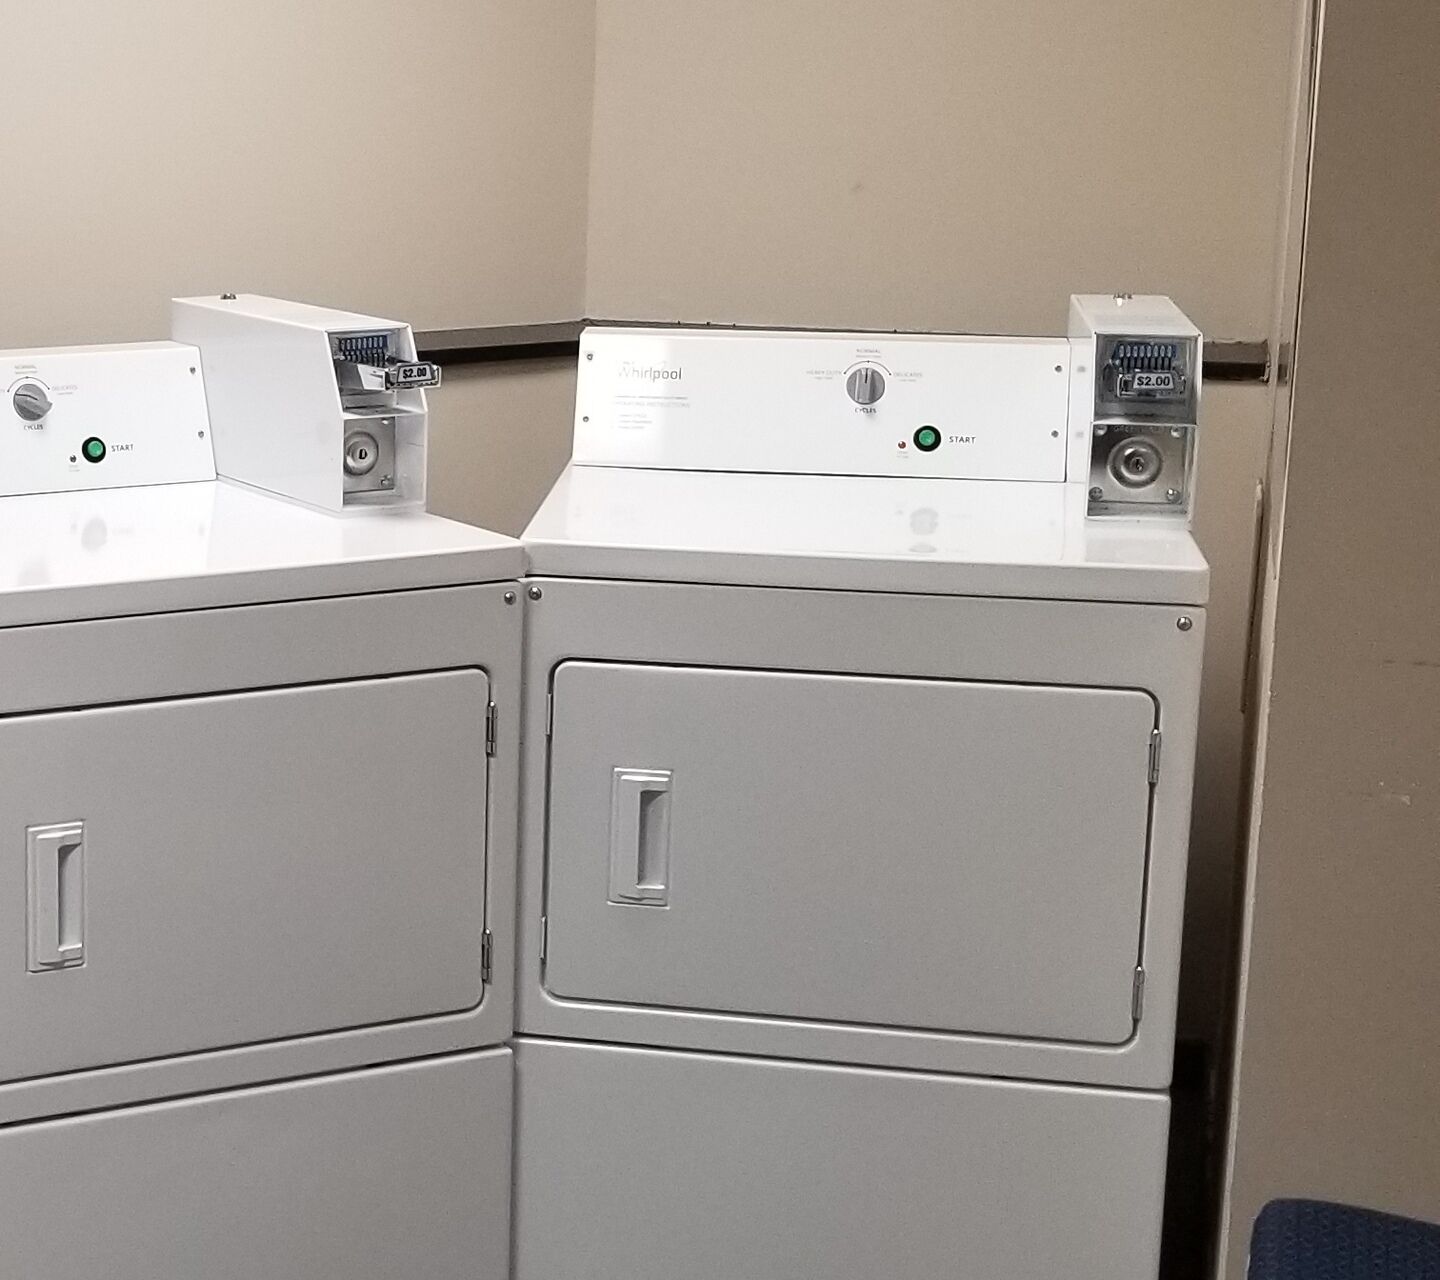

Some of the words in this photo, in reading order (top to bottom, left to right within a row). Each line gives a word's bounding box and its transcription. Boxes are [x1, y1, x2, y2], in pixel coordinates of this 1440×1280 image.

[402, 366, 427, 380] $2.00
[1136, 375, 1171, 387] $2.00
[949, 435, 976, 445] START
[111, 444, 134, 452] START
